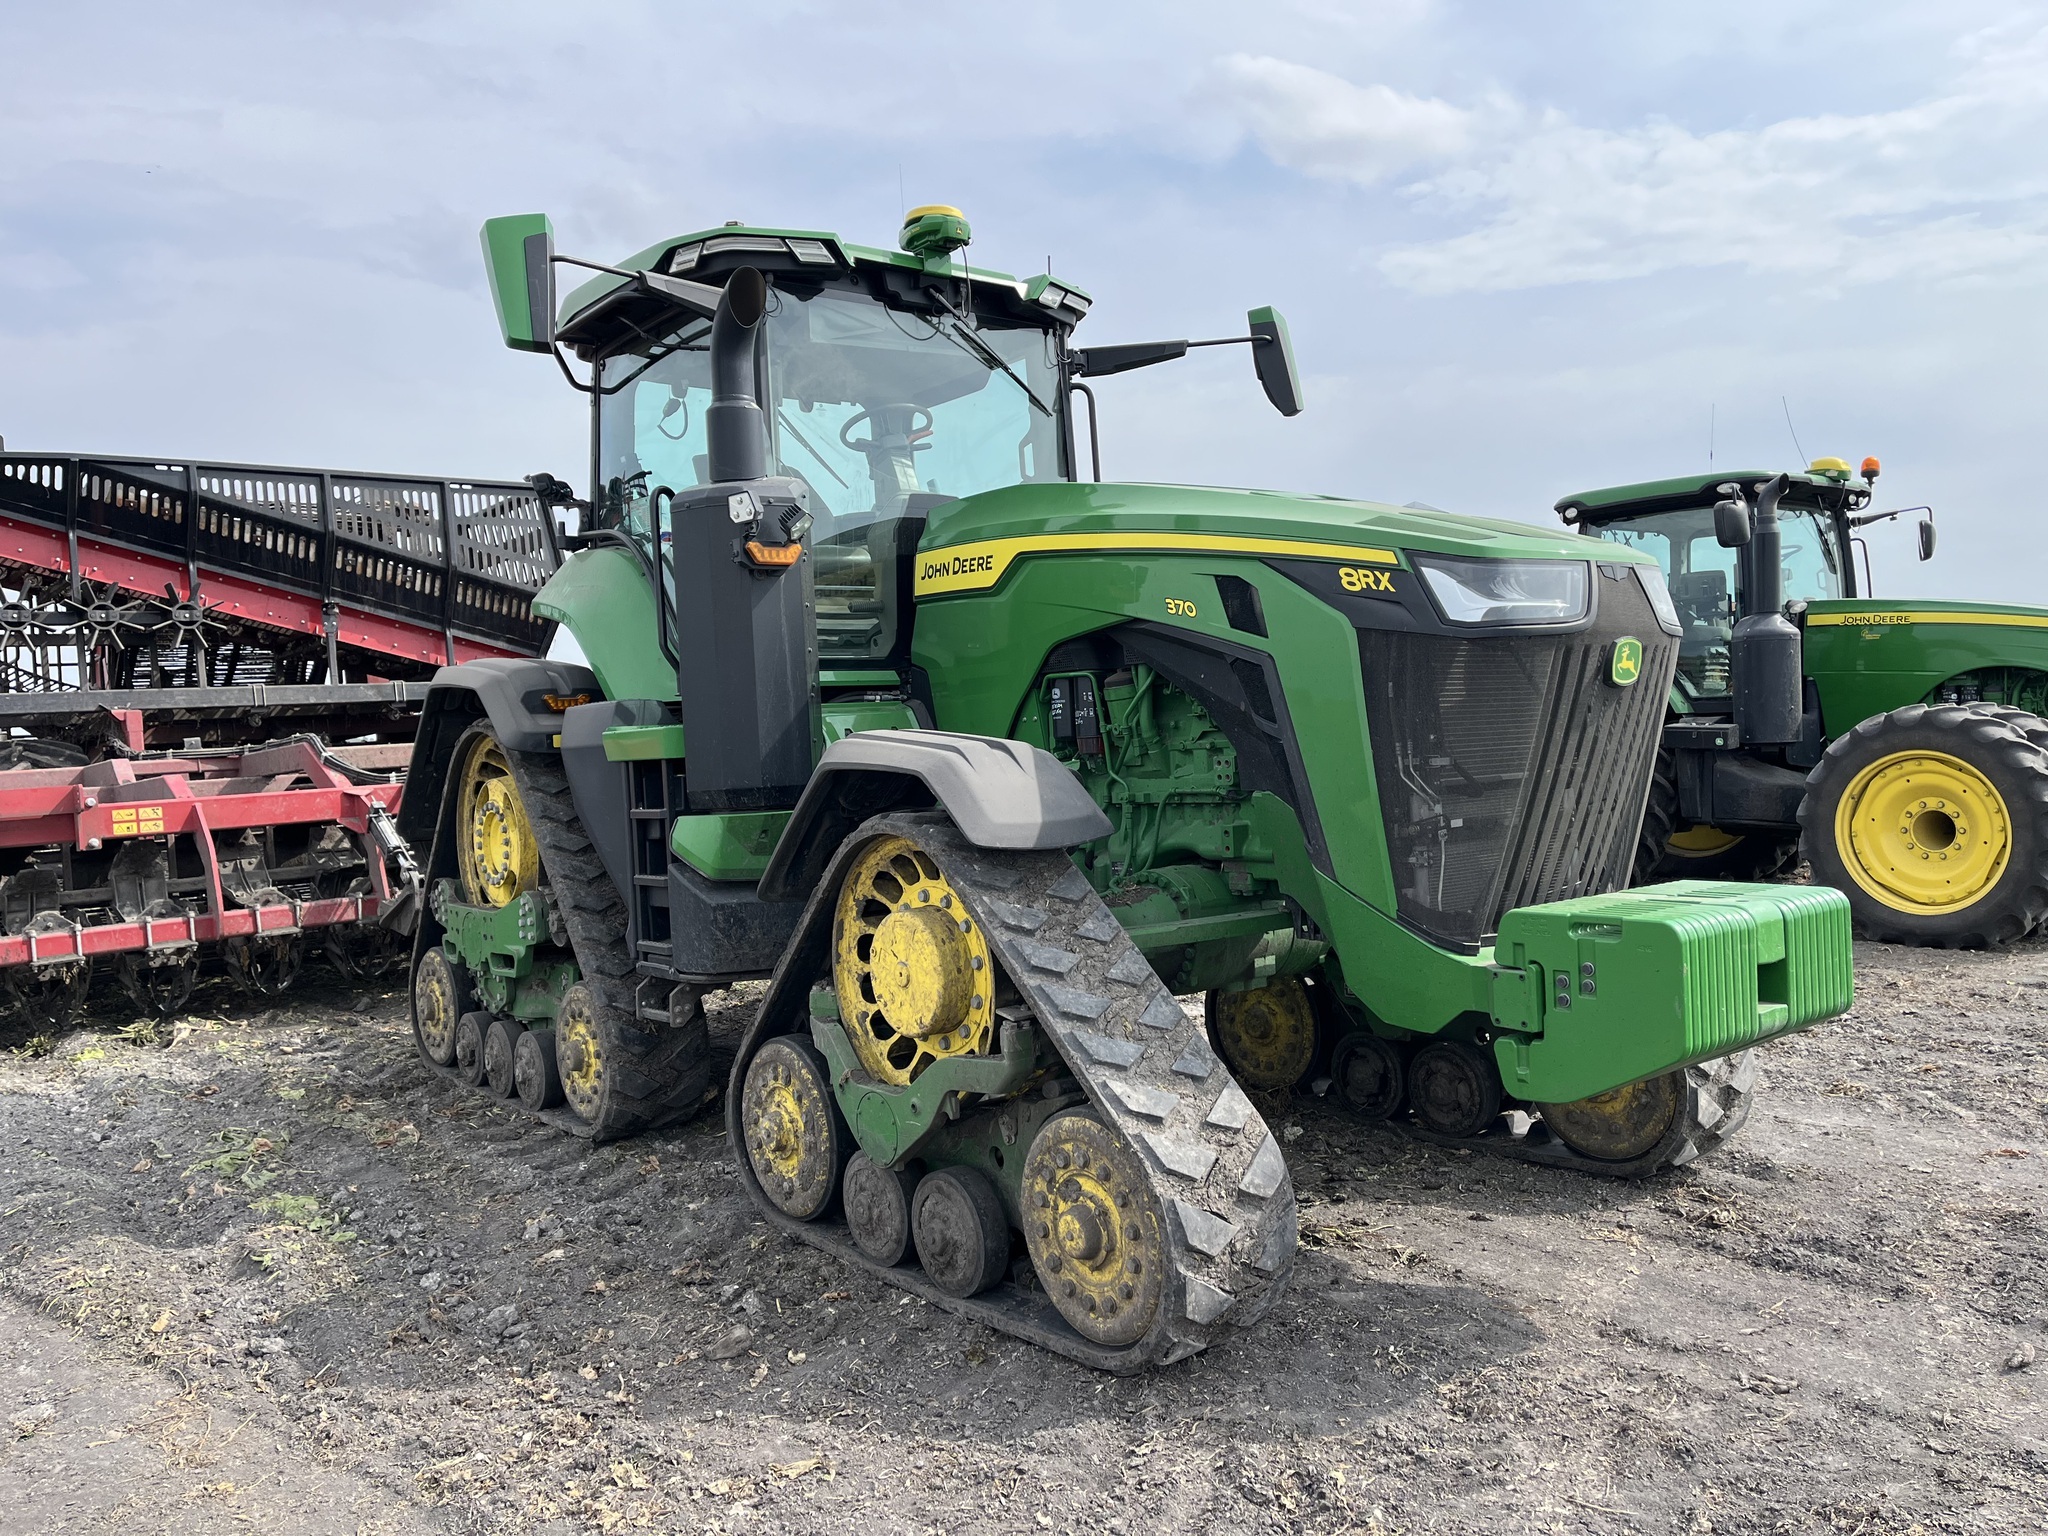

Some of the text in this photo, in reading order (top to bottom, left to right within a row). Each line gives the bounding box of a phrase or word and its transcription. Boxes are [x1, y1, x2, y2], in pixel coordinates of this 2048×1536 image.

[921, 556, 994, 581] JOHN DEERE
[1338, 567, 1397, 592] 8RX
[1164, 597, 1197, 618] 370
[1840, 614, 1911, 625] JOHN DEERE
